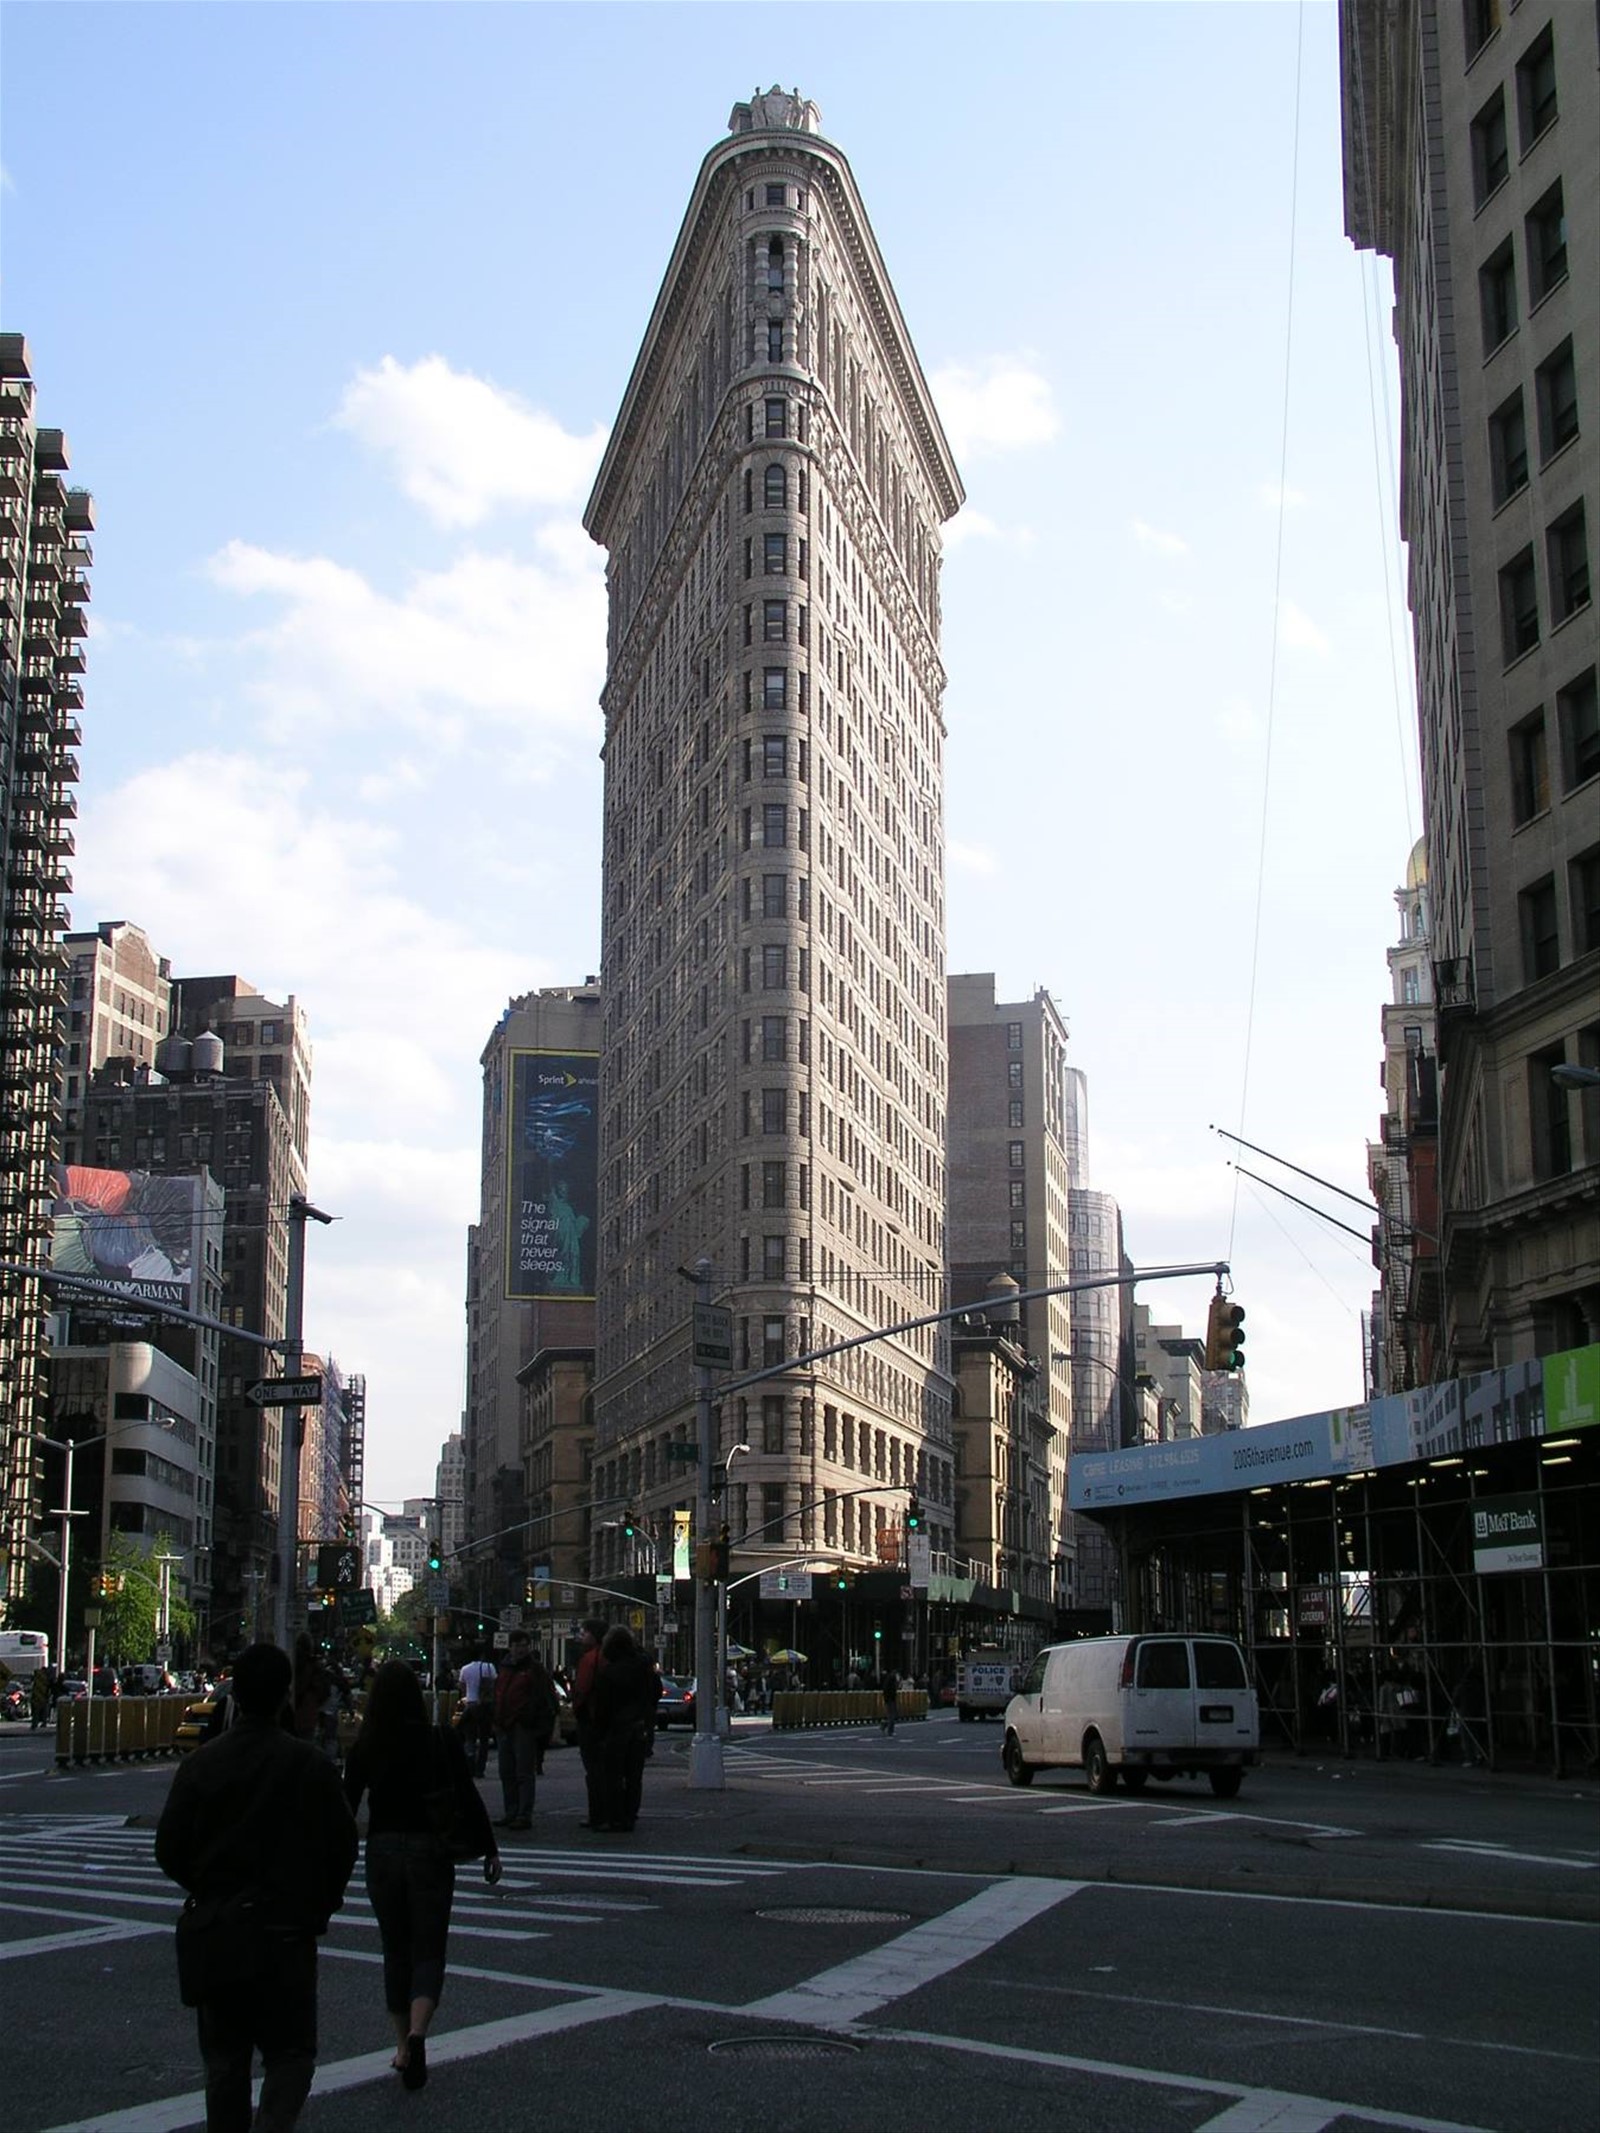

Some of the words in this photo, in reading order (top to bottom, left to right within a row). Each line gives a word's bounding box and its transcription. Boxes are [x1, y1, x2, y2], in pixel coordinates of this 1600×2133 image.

[538, 1074, 564, 1086] Sprint
[521, 1201, 546, 1214] The
[521, 1218, 560, 1232] signal
[521, 1232, 548, 1245] that
[520, 1247, 558, 1258] never
[519, 1259, 566, 1272] sleeps.
[134, 1284, 184, 1301] ARMANI
[254, 1387, 278, 1399] ONE
[292, 1384, 315, 1397] WAY
[1233, 1439, 1314, 1470] 2005thavenue.com
[1488, 1512, 1509, 1533] M&T
[1510, 1509, 1537, 1531] Bank
[972, 1667, 1006, 1675] POLICE
